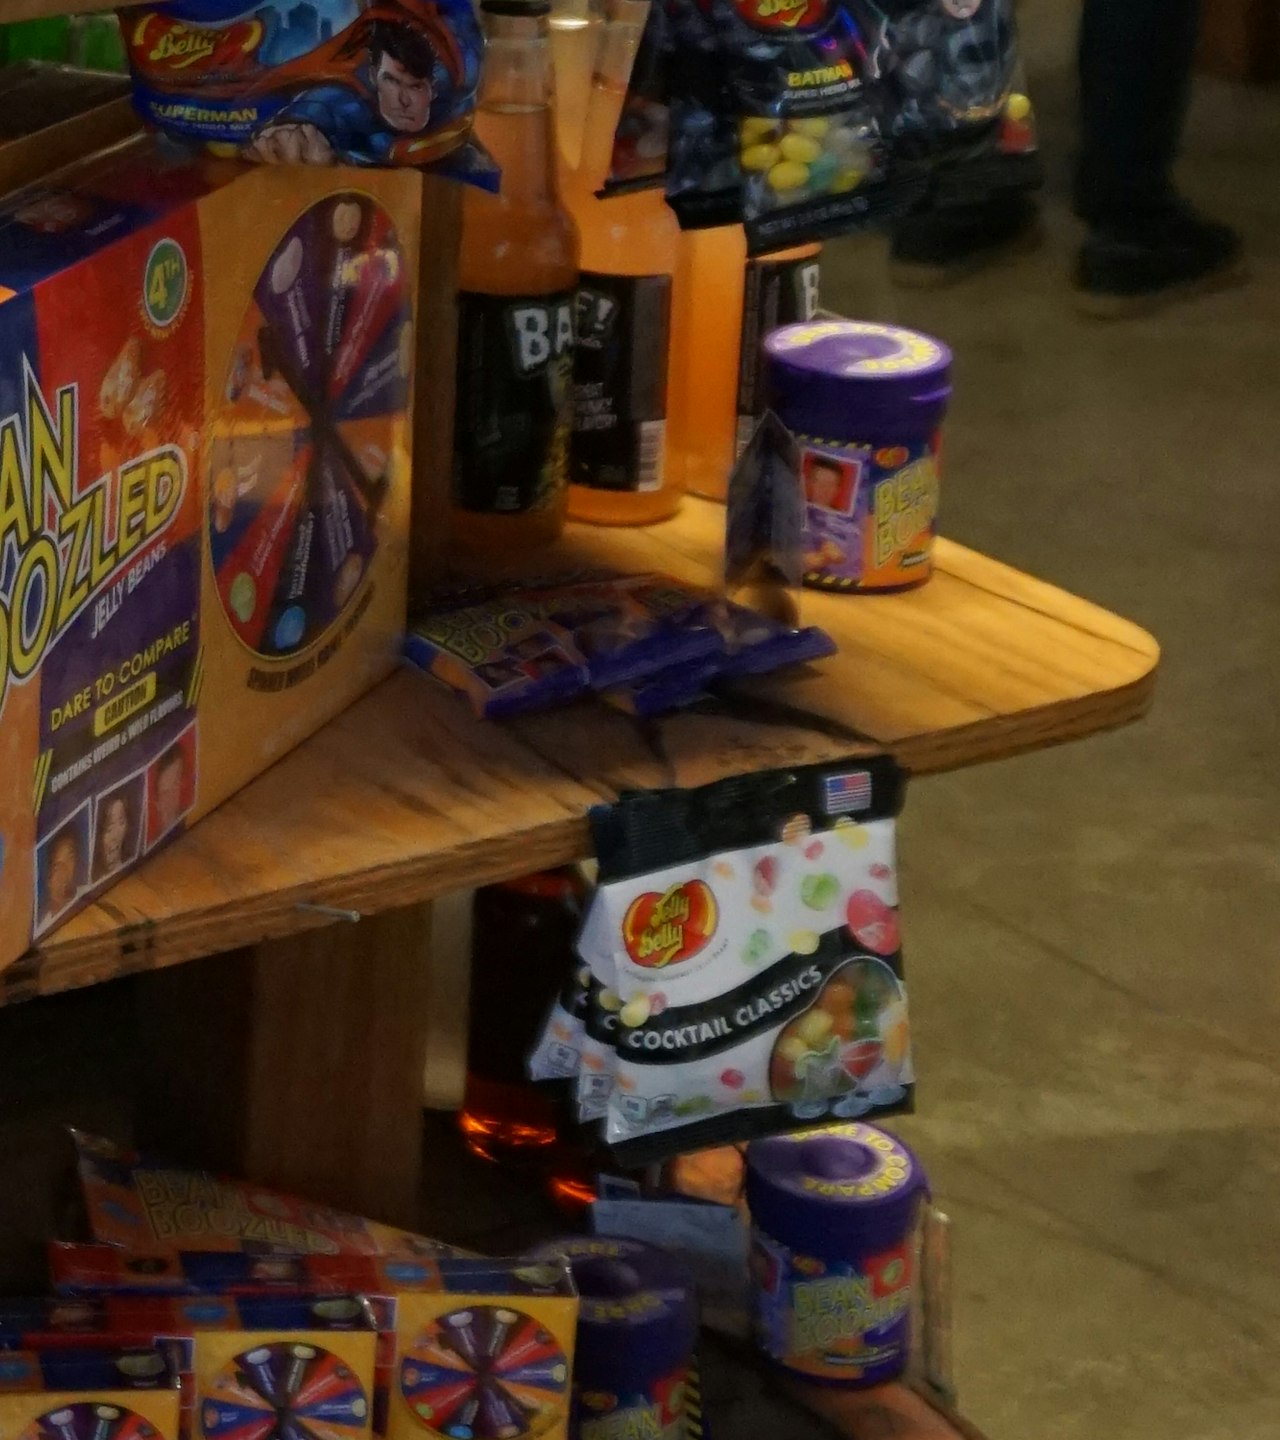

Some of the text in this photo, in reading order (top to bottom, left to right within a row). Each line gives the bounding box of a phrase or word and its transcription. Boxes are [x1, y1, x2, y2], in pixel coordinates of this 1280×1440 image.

[146, 255, 185, 314] 4TH
[91, 540, 168, 640] JELLY BEANS
[50, 620, 192, 732] DARE TO COMPARE
[628, 964, 823, 1050] COCKTAIL CLASSICS
